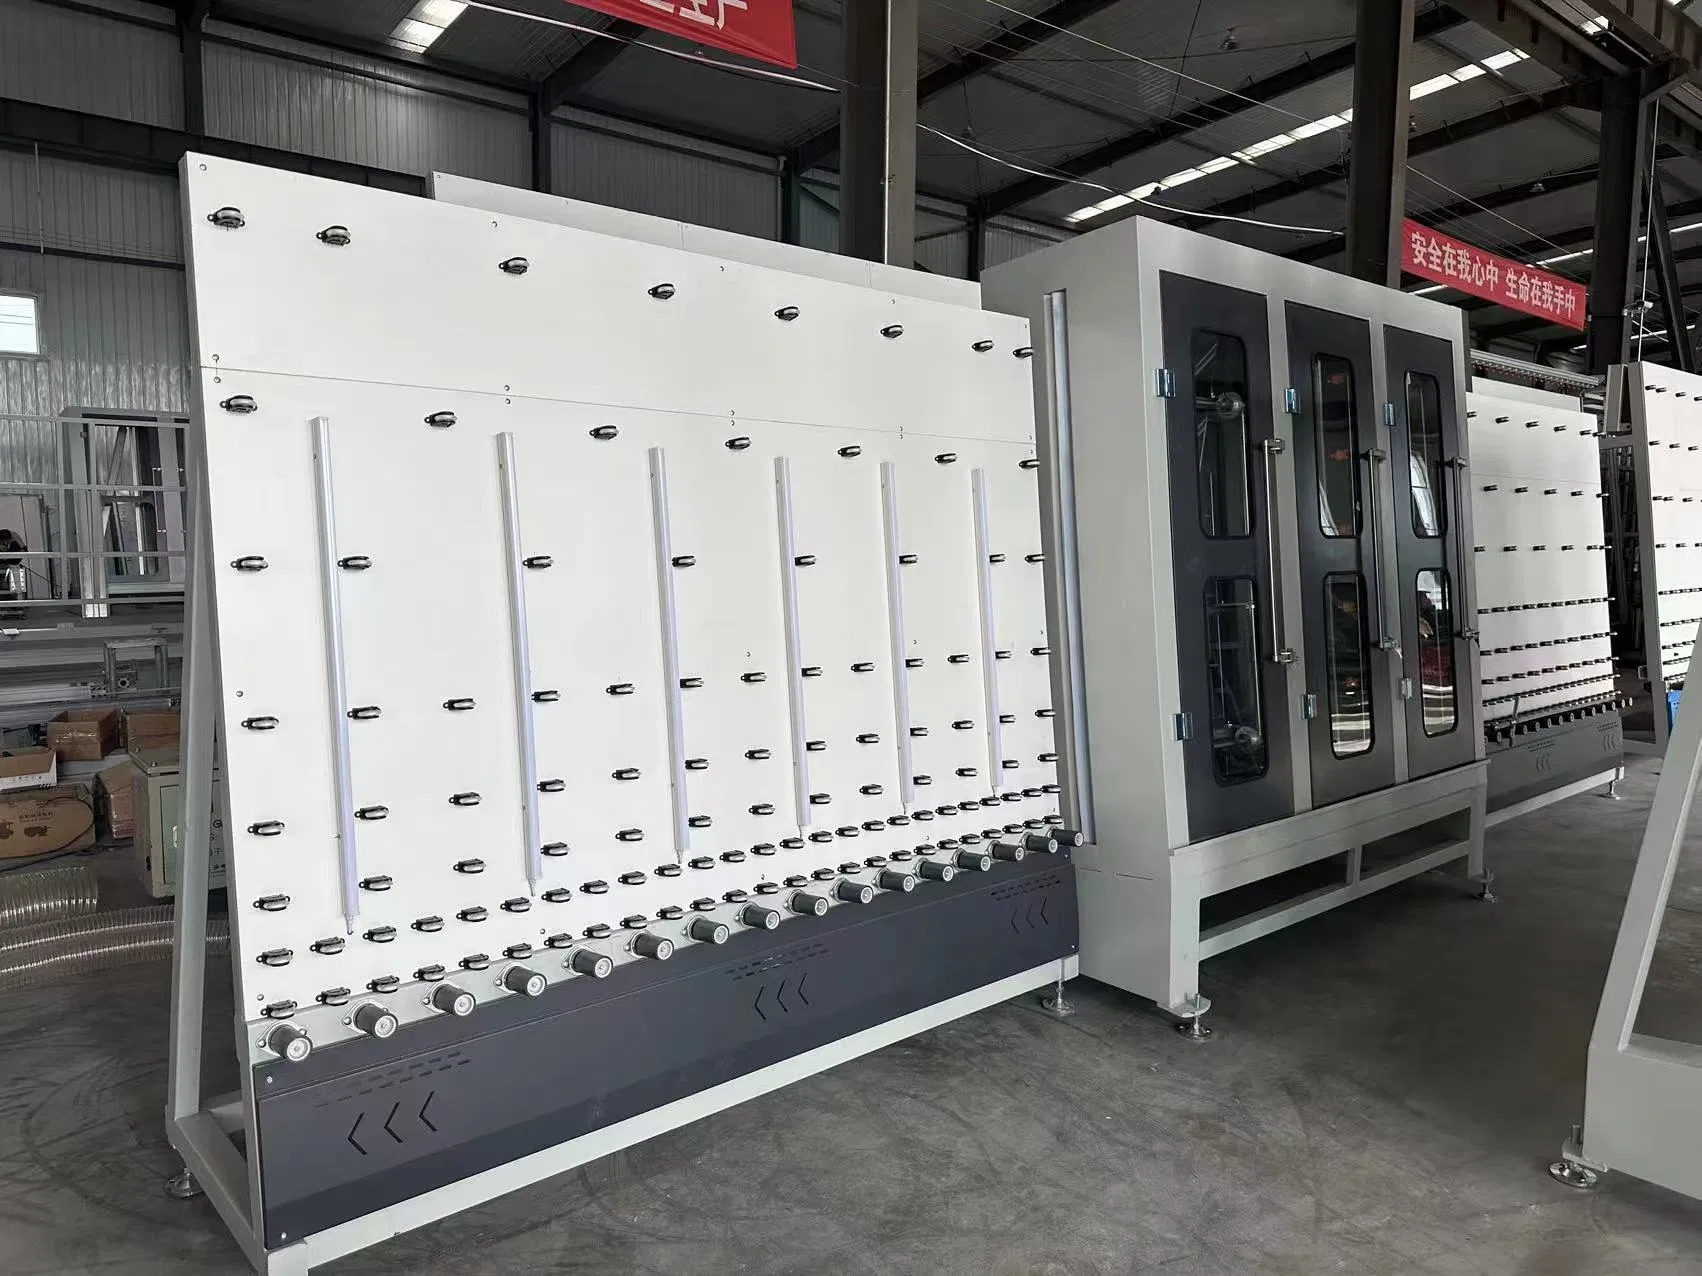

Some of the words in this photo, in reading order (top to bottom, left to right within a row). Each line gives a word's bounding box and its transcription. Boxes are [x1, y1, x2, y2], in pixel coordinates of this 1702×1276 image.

[1411, 232, 1499, 292] 安全在我心中
[1505, 267, 1576, 318] 生命在我手中
